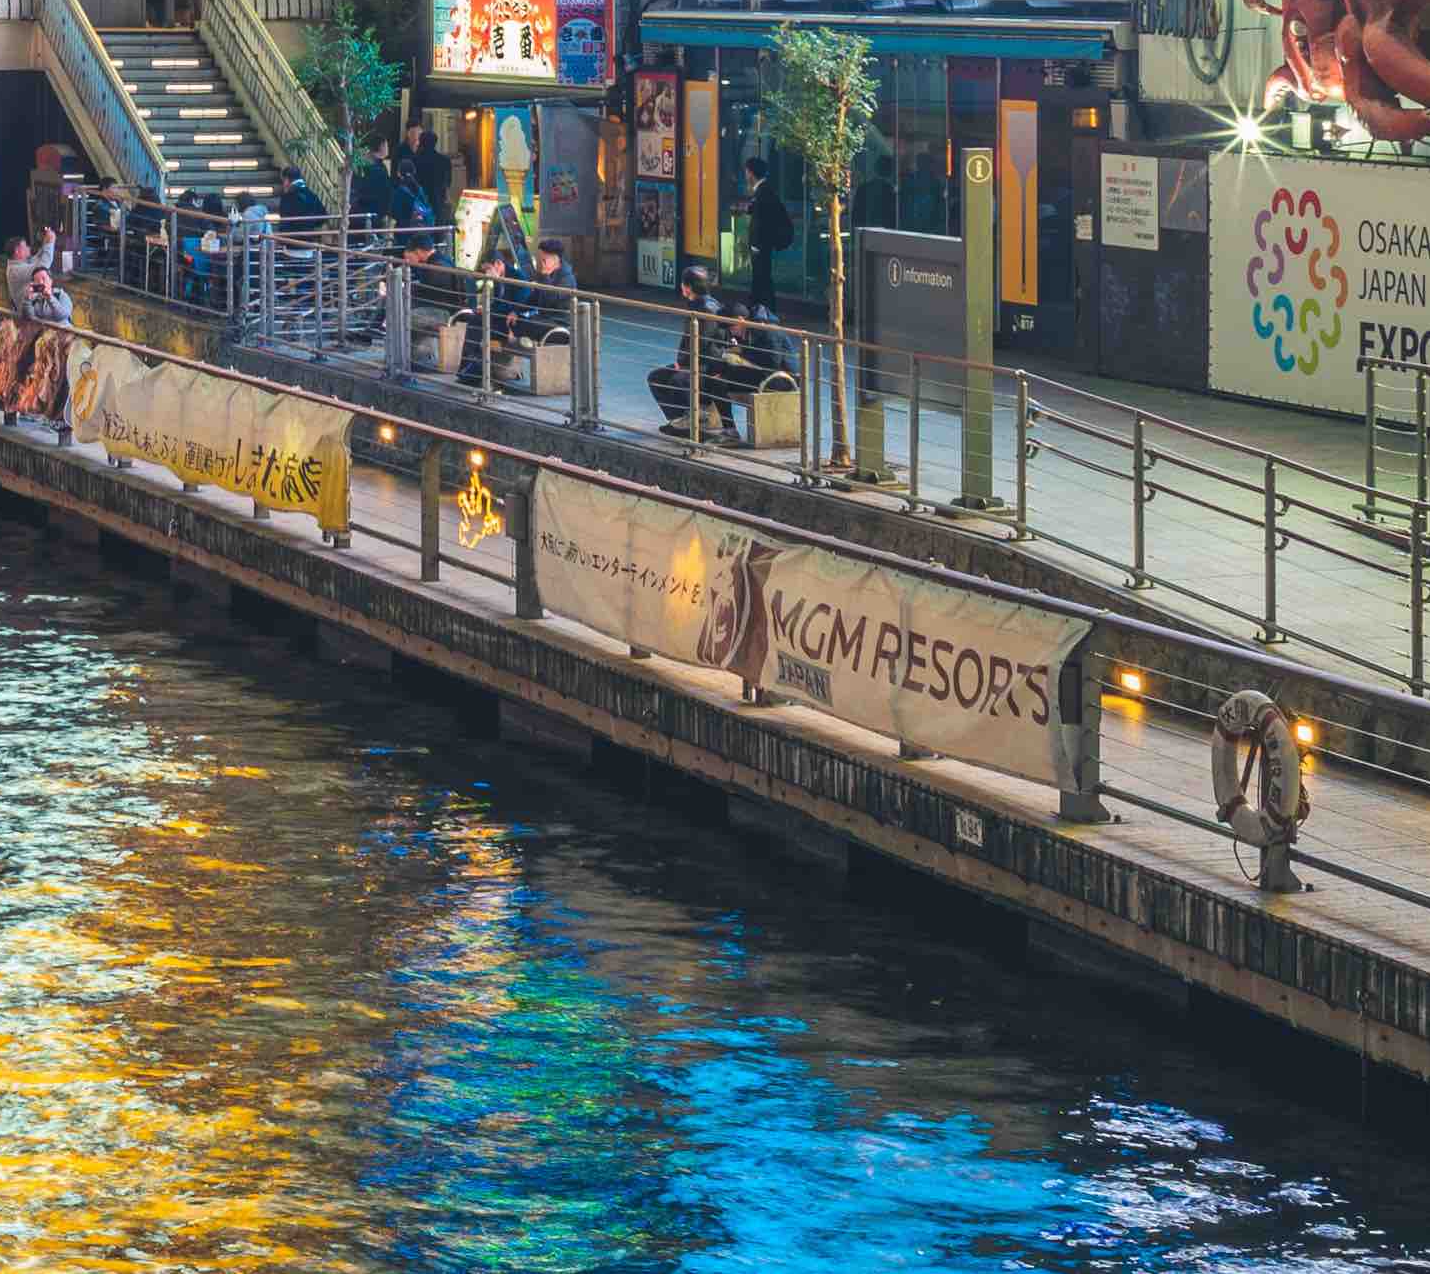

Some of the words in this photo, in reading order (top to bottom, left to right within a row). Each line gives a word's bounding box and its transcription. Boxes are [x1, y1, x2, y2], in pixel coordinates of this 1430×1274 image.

[1357, 269, 1428, 309] JAPAN
[771, 588, 869, 674] MGM
[870, 621, 1051, 727] RESORTS
